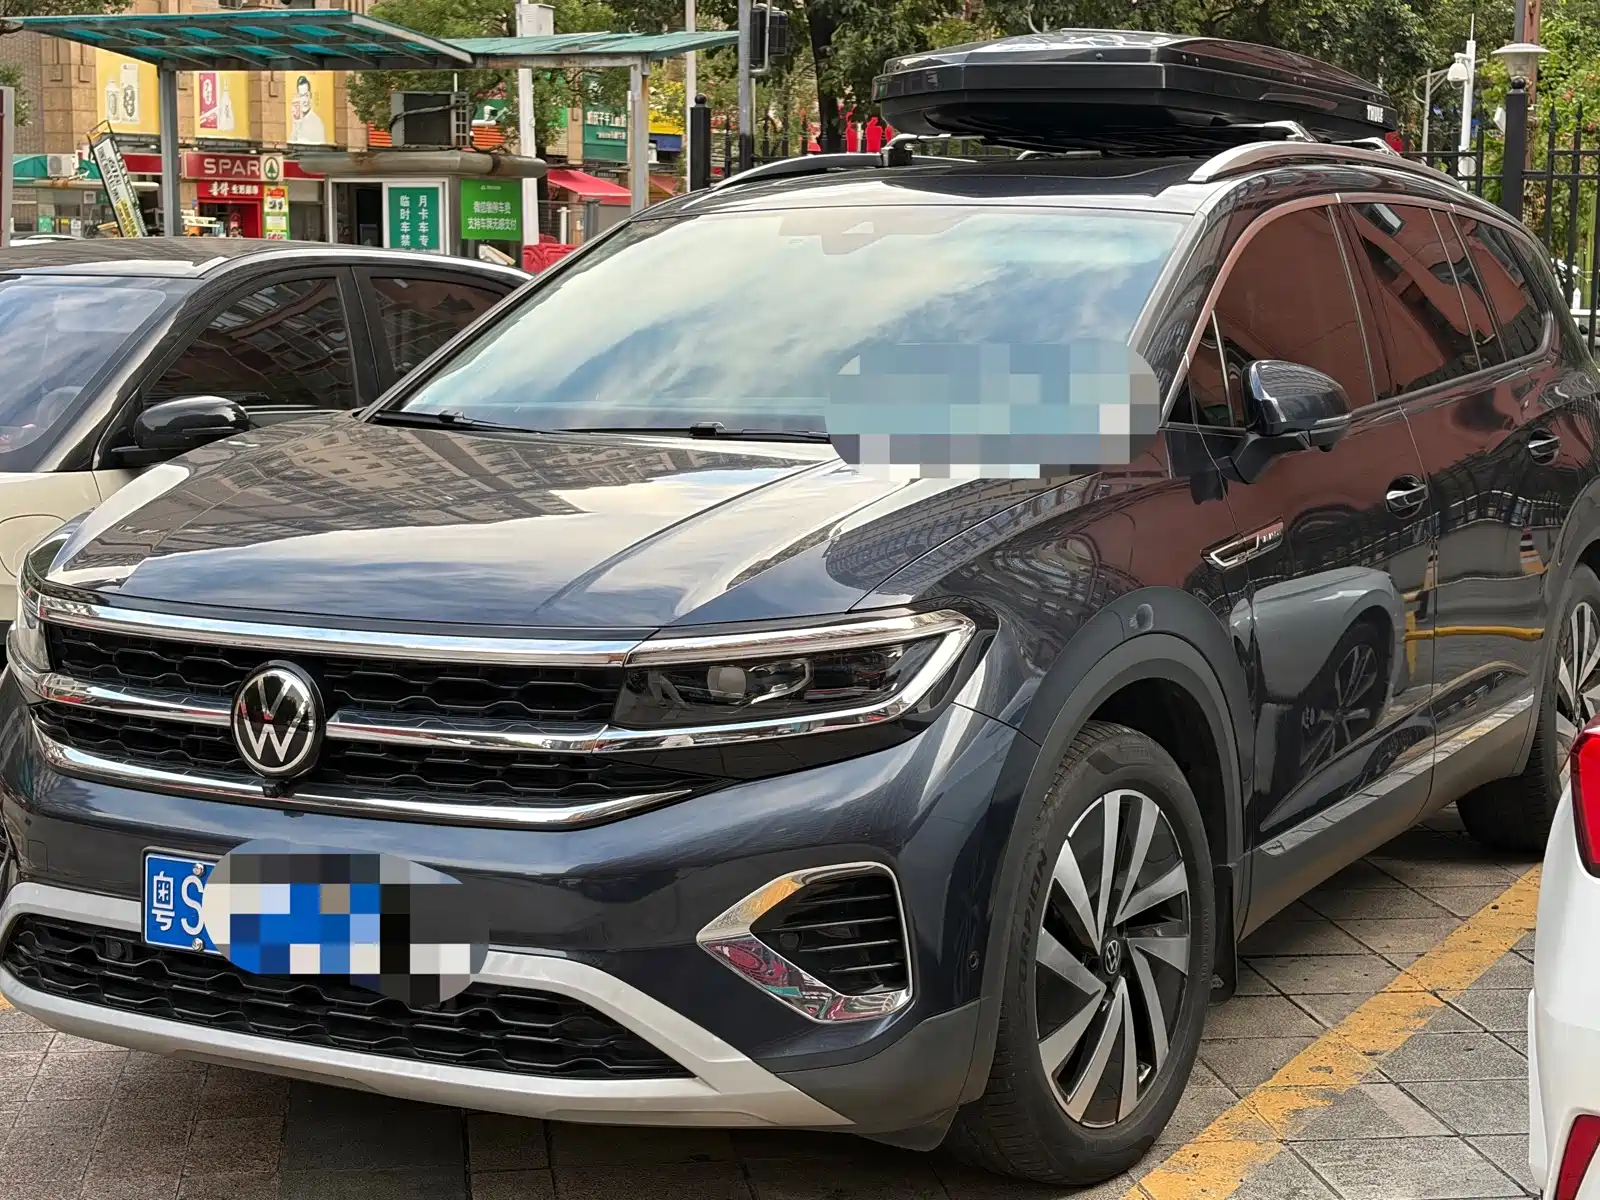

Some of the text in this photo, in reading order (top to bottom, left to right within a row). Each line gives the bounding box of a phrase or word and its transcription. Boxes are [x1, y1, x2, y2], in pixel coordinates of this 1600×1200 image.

[1366, 105, 1384, 123] THULE
[203, 158, 260, 176] SPAR
[400, 194, 411, 247] 临时车禁
[418, 194, 429, 247] 月卡车专
